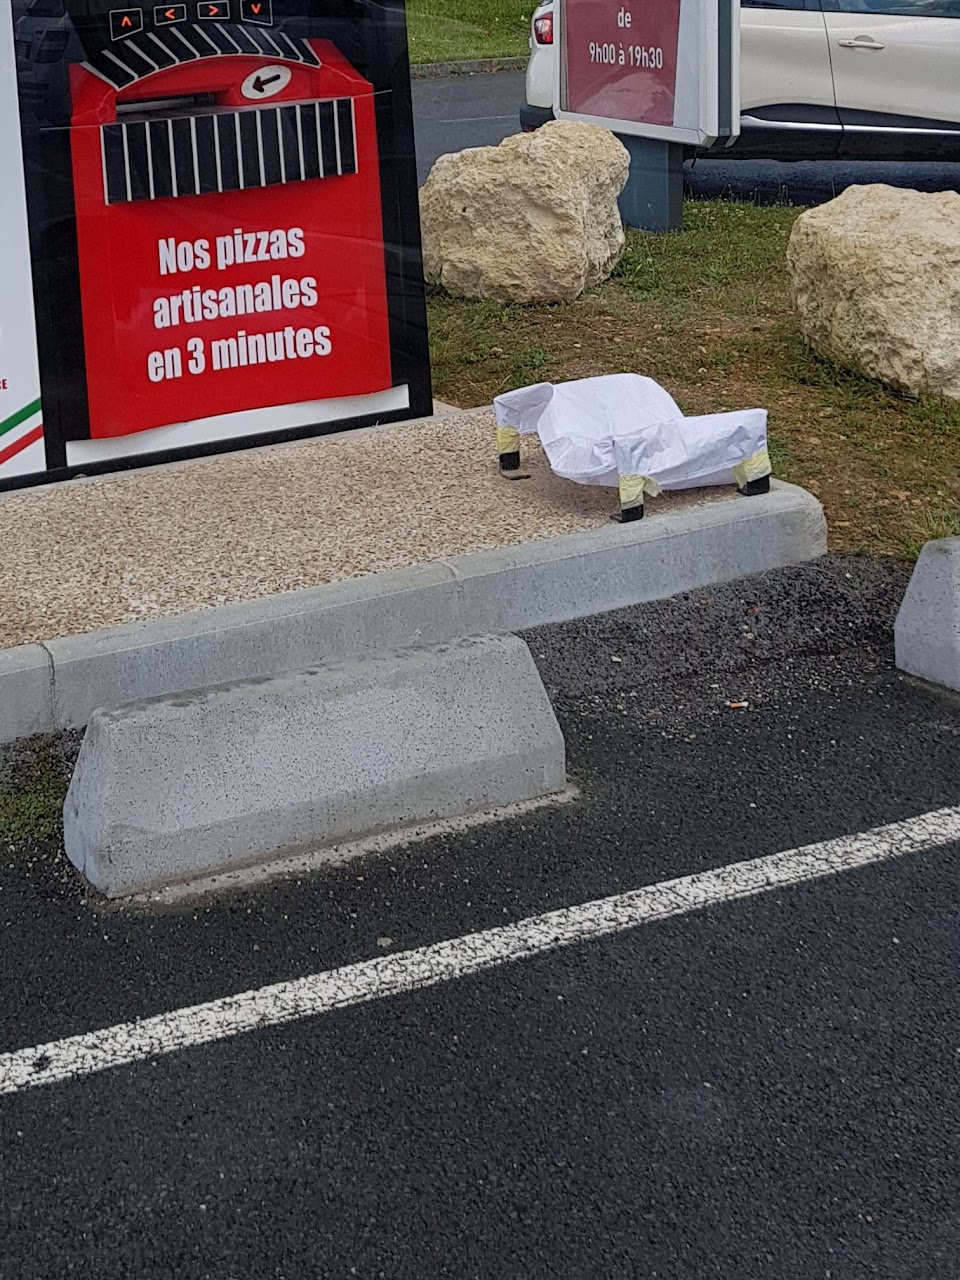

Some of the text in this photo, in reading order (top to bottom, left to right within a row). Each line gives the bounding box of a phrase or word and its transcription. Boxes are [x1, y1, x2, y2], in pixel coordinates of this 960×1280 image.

[617, 6, 632, 28] de
[589, 44, 663, 69] 9h00 à 19h30
[158, 227, 305, 276] Nos pizzas
[153, 275, 318, 329] artisanales
[147, 325, 332, 383] en 3 minutes
